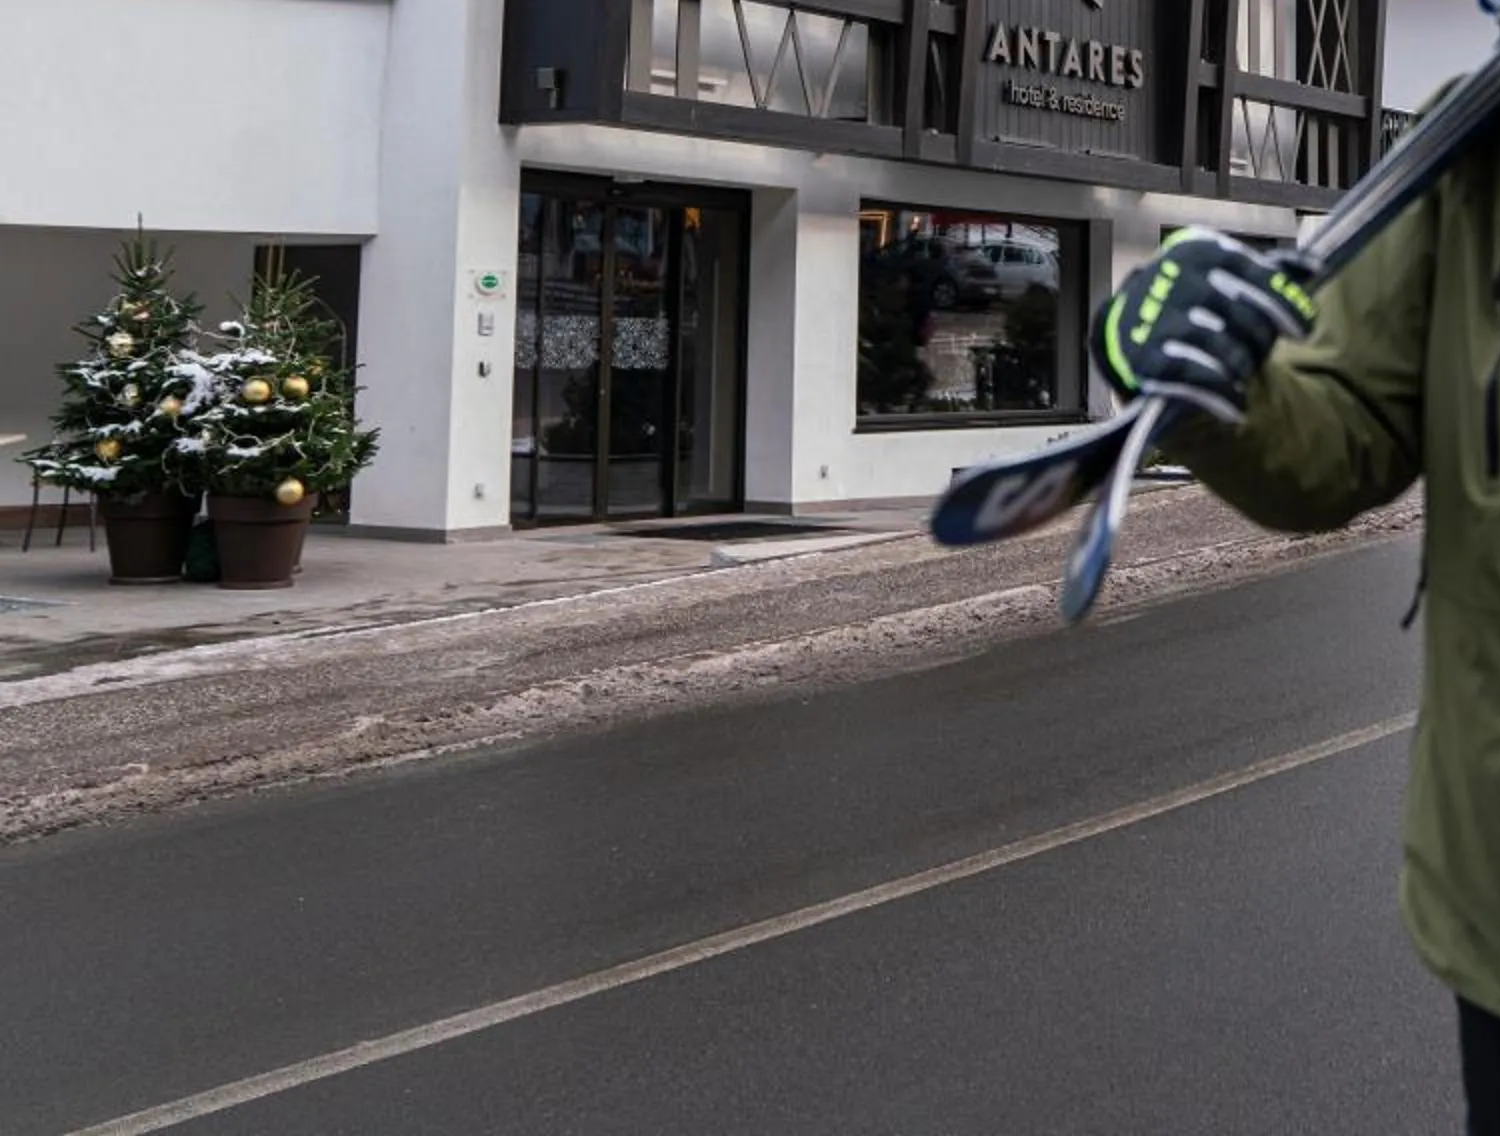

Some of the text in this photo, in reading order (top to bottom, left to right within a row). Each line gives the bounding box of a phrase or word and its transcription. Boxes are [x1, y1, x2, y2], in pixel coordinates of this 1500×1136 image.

[989, 22, 1145, 89] ANTARES
[1009, 79, 1125, 121] hotel & residence
